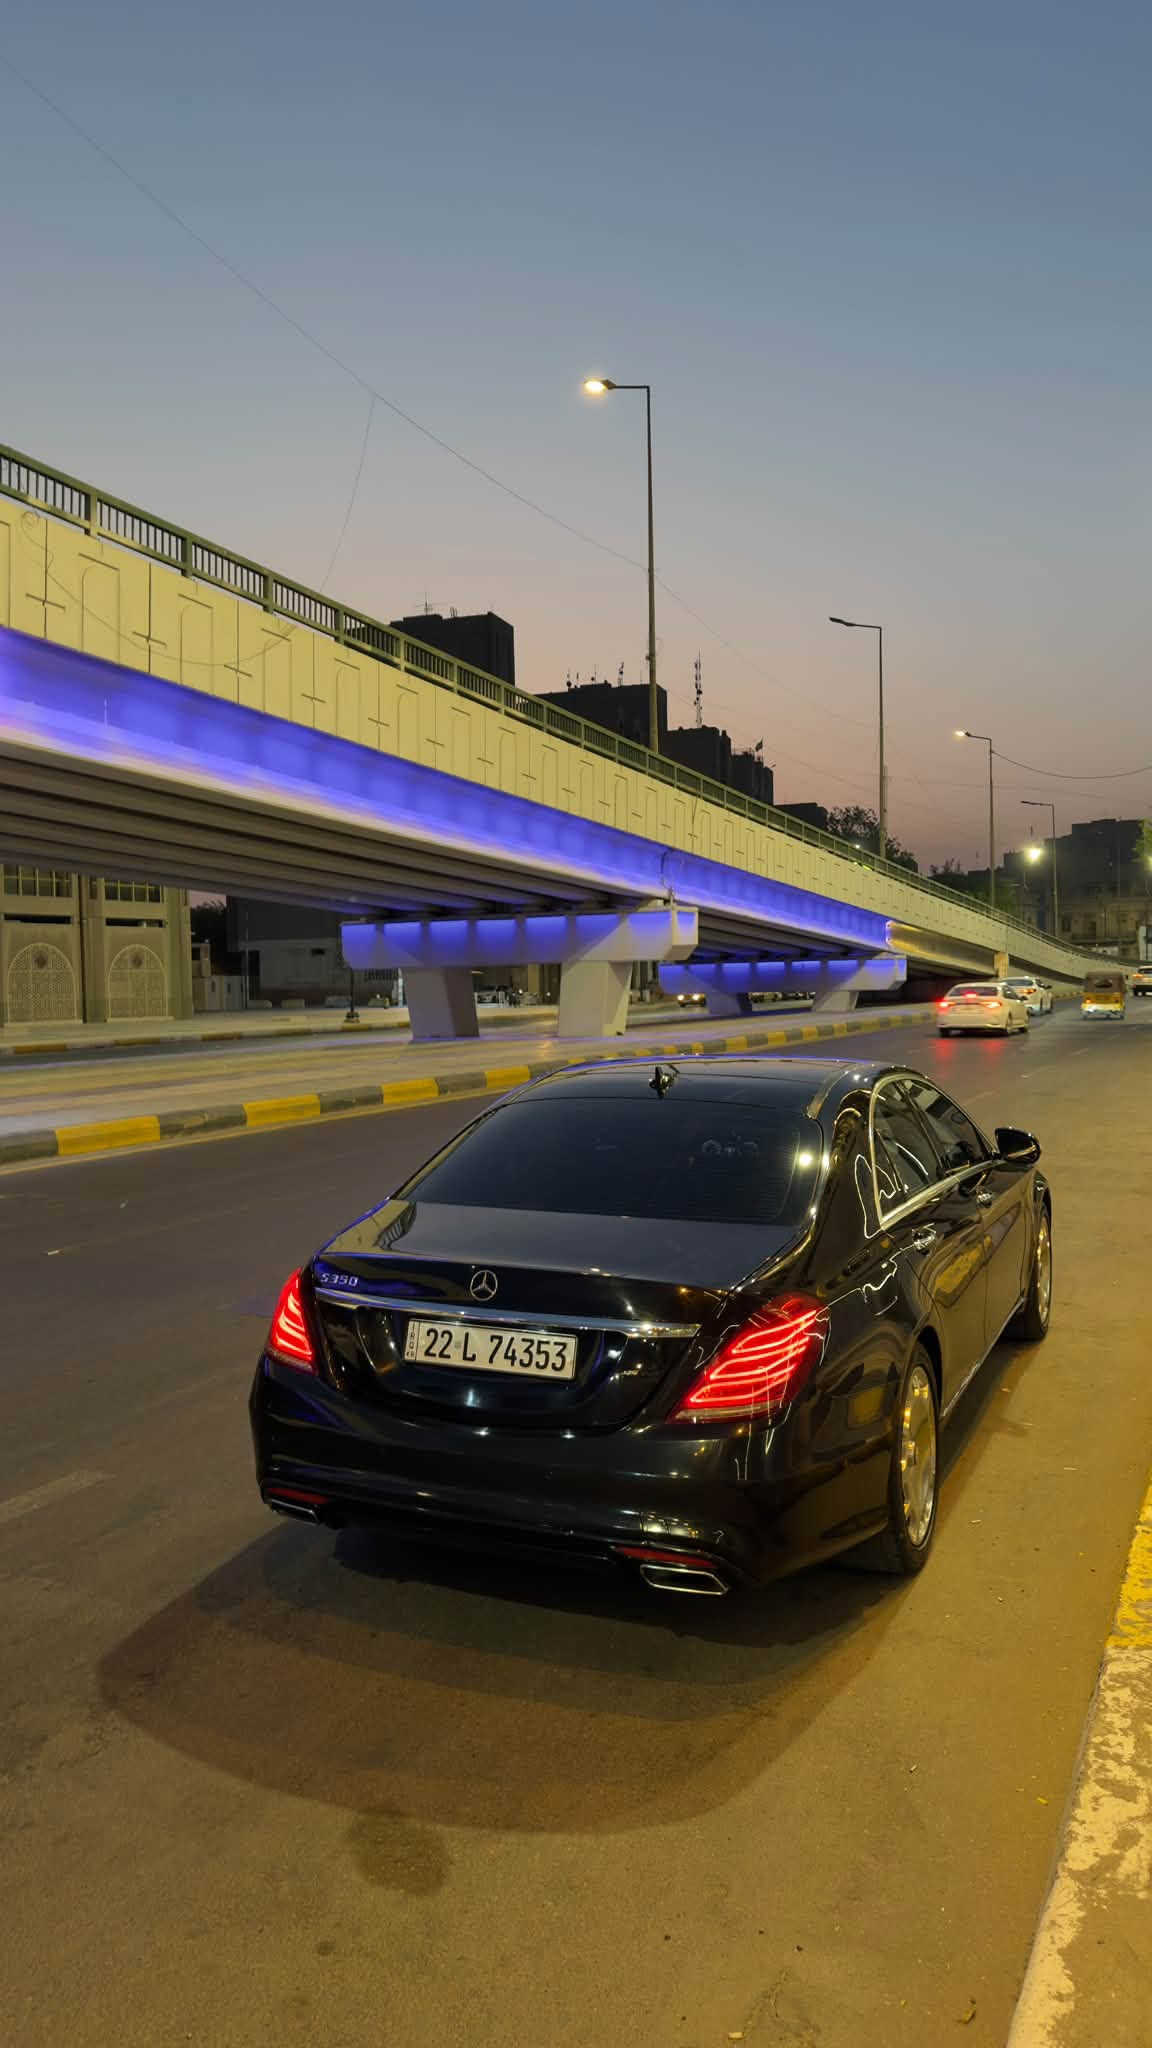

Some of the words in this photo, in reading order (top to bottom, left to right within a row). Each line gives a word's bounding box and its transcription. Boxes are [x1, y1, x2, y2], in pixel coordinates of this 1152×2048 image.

[424, 1328, 453, 1359] 22
[462, 1332, 477, 1362] L
[488, 1335, 568, 1371] 74353
